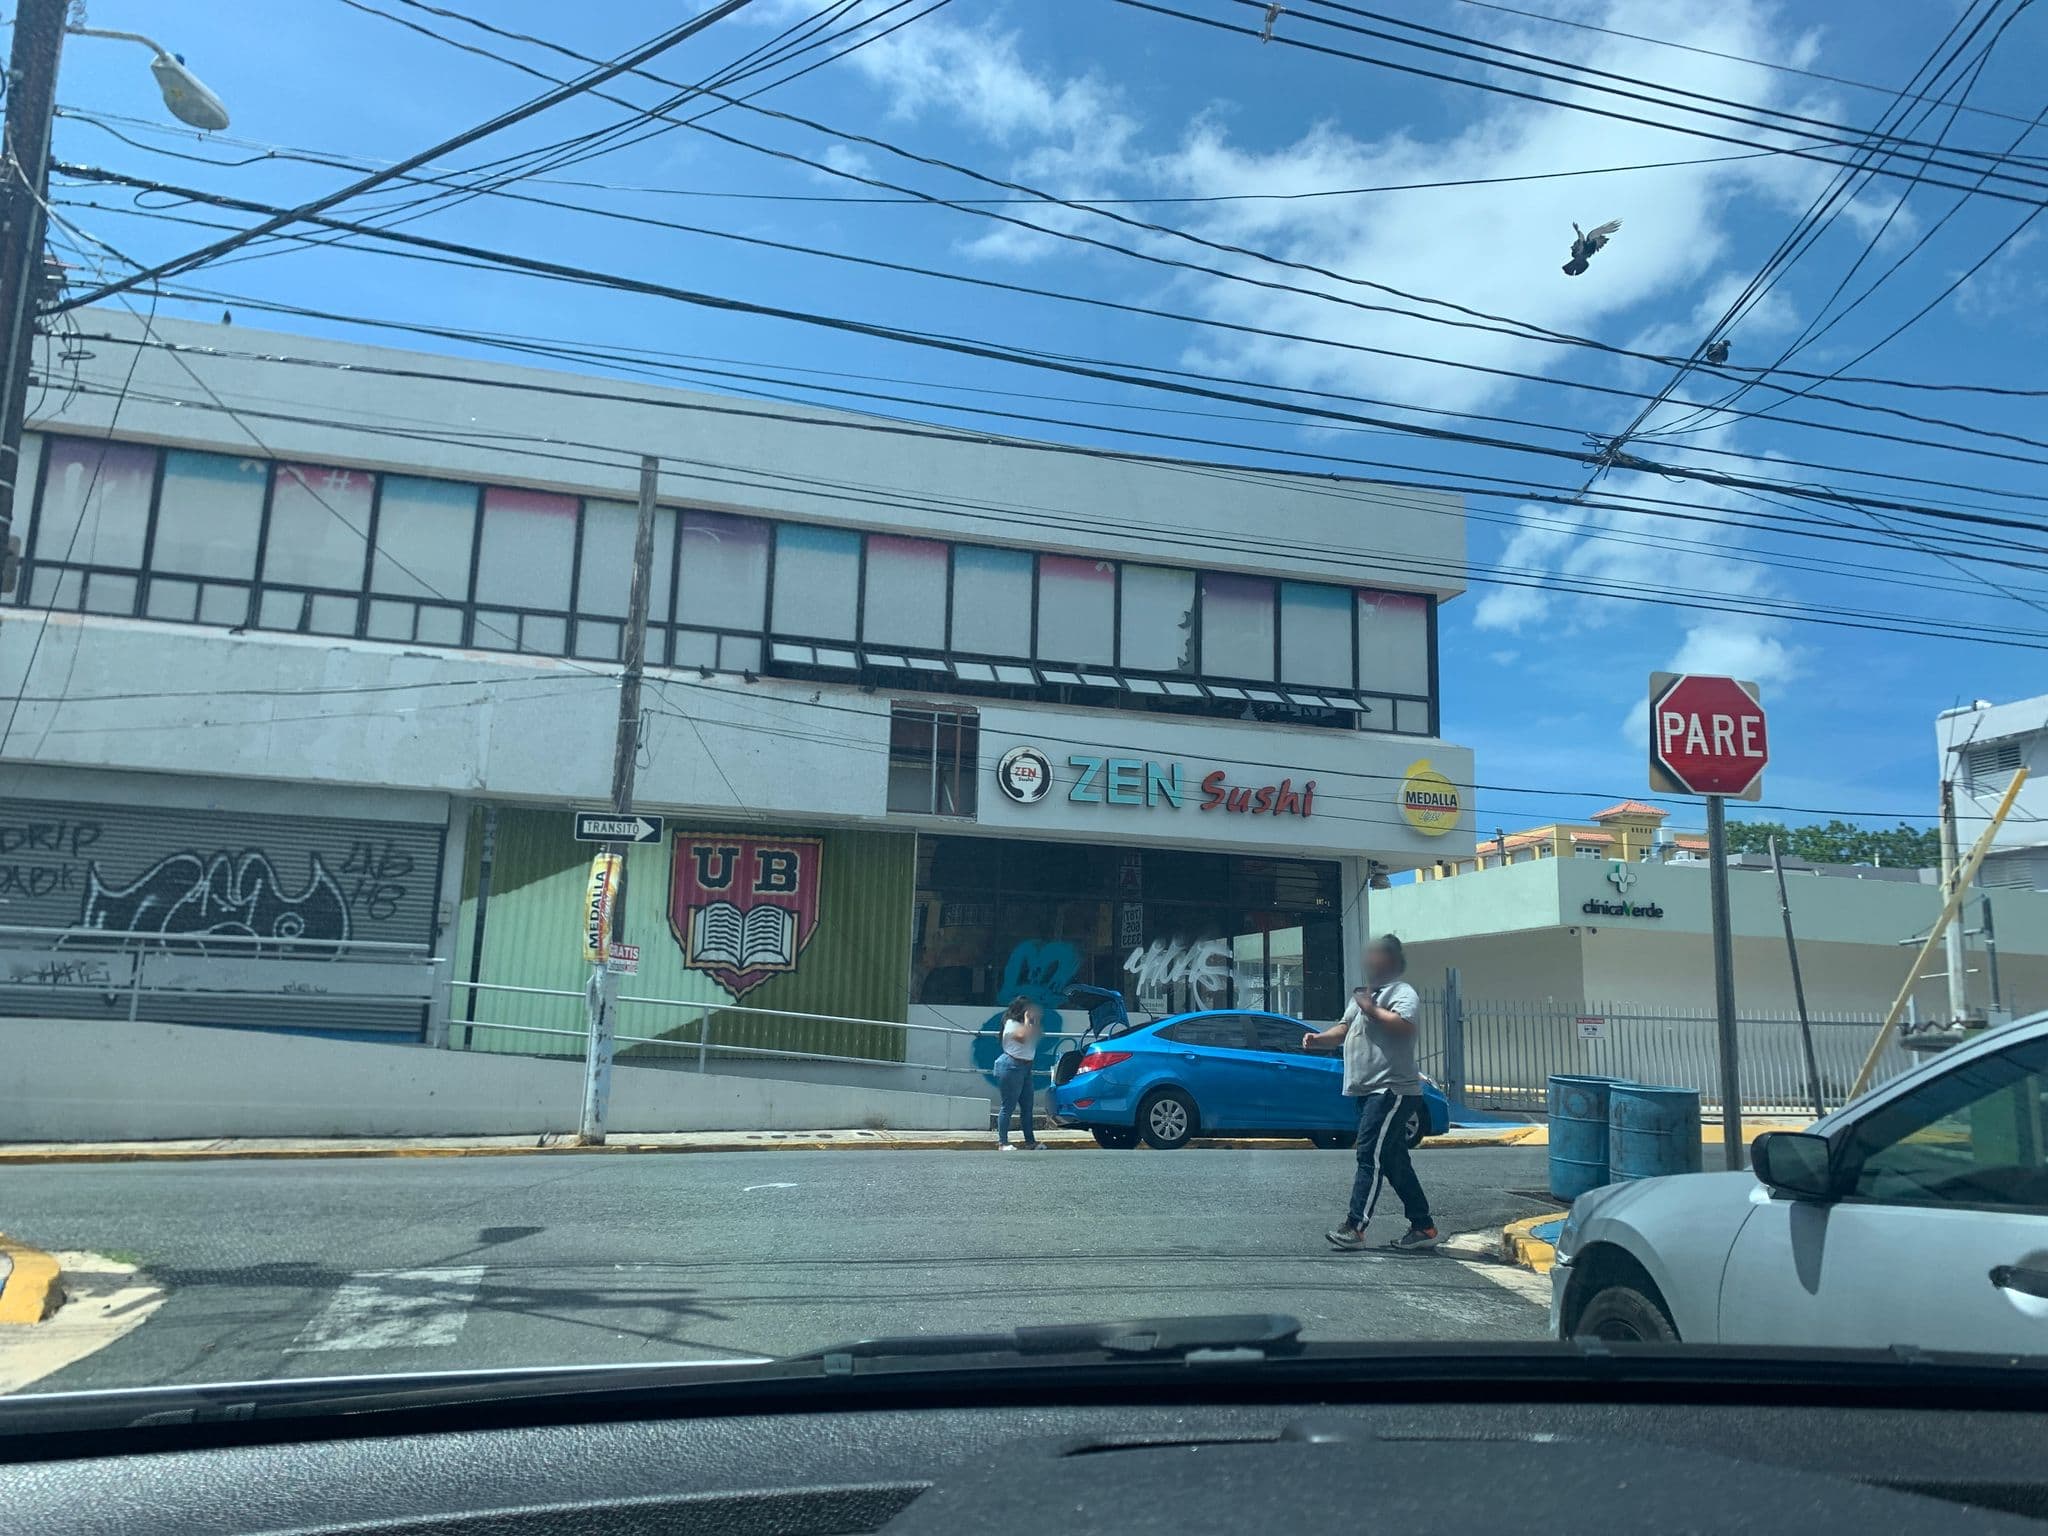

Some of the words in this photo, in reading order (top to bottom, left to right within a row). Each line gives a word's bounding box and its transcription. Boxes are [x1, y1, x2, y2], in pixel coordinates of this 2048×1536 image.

[1662, 711, 1764, 758] PARE
[1015, 766, 1037, 778] ZEN
[1068, 755, 1184, 809] ZEN
[1200, 770, 1317, 817] Sushi
[1405, 790, 1458, 807] MEDALLA
[587, 821, 640, 834] TRANSITO
[588, 871, 606, 949] MEDALLA
